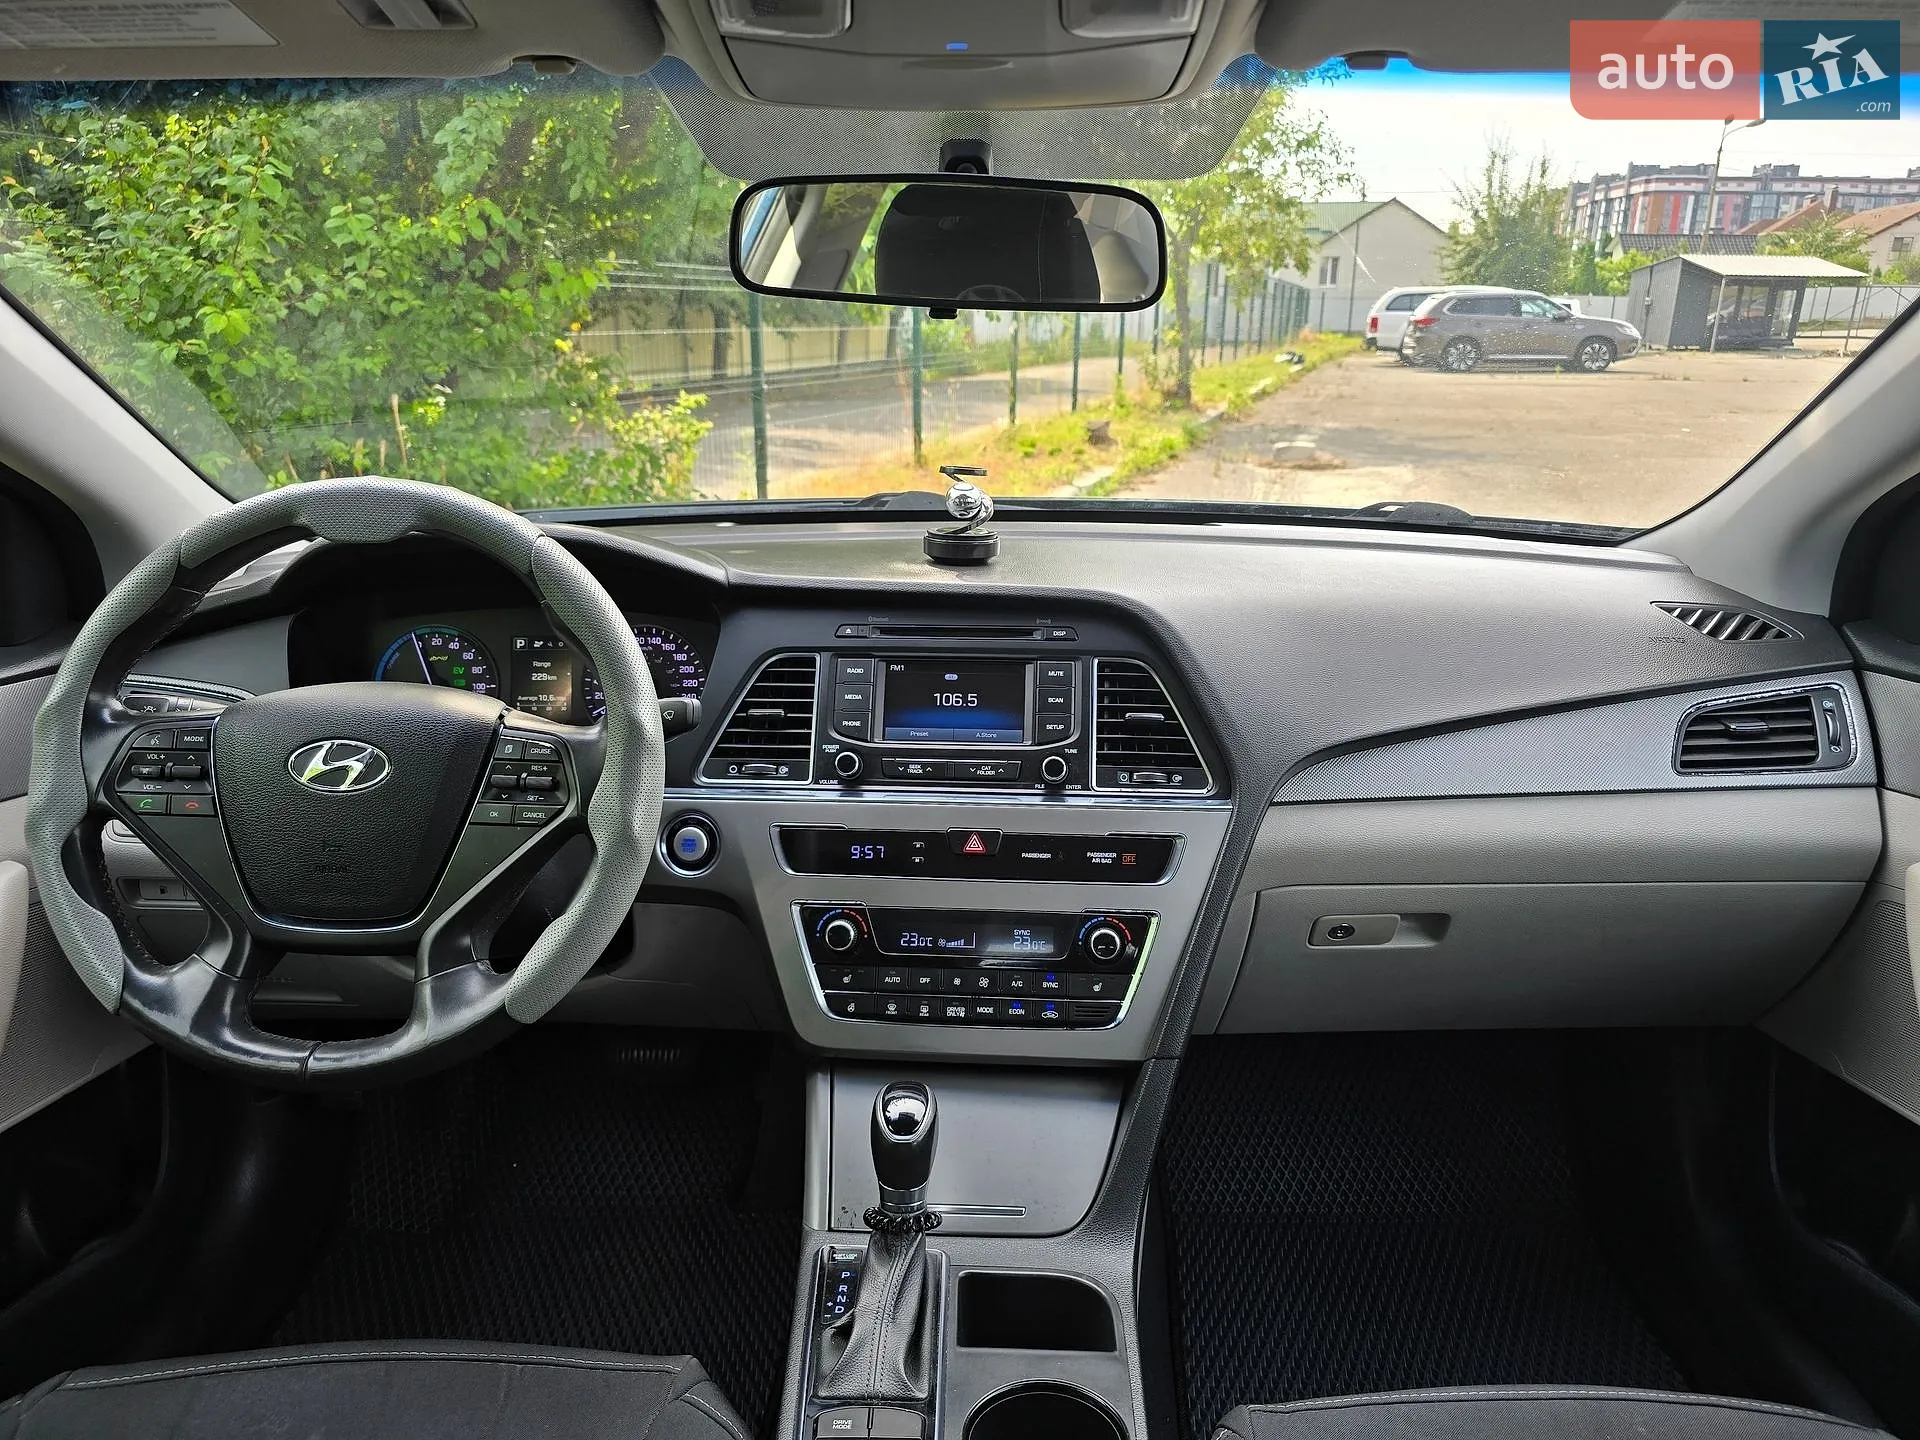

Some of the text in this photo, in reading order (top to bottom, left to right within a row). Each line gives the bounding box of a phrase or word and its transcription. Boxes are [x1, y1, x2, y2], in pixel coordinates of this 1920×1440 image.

[431, 638, 443, 646] 20
[516, 640, 525, 649] P
[647, 637, 662, 645] 140
[448, 642, 460, 650] 40
[661, 643, 676, 651] 160
[673, 653, 688, 661] 180
[453, 666, 465, 674] EV
[471, 666, 483, 674] 80
[682, 679, 698, 687] 220
[933, 693, 978, 707] 106.5
[850, 845, 885, 859] 9:57
[1122, 855, 1136, 863] OFF
[841, 1271, 850, 1279] P
[836, 1295, 847, 1303] N
[834, 1305, 845, 1313] D
